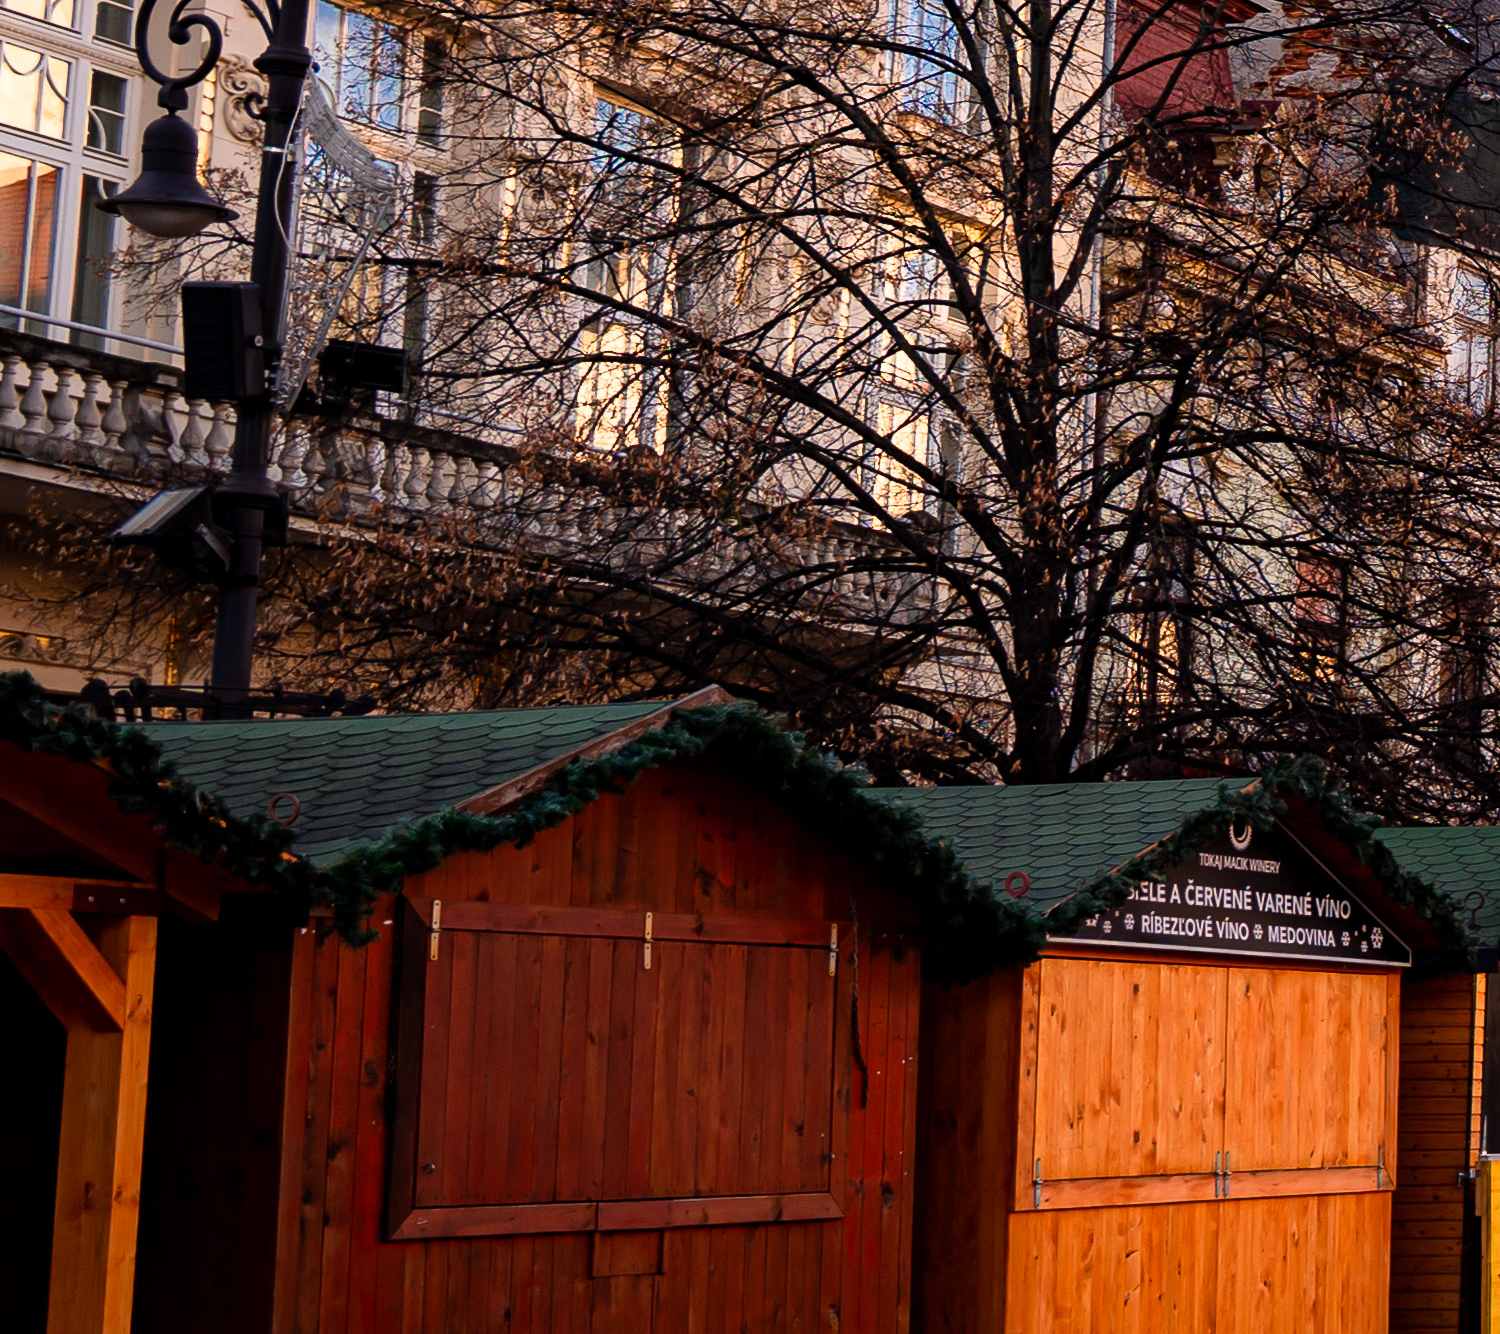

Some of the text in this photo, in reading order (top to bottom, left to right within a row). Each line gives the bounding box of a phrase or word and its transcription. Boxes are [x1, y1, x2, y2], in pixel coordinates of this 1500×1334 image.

[1199, 853, 1281, 874] TOKAJ MACIK WINERY
[1169, 883, 1181, 904] A
[1185, 878, 1252, 911] ČERVENÉ
[1256, 887, 1312, 917] VARENÉ
[1315, 892, 1351, 920] VÍNO
[1141, 911, 1336, 947] RÍBEZĽOVÉ VÍNO MEDOVINA
